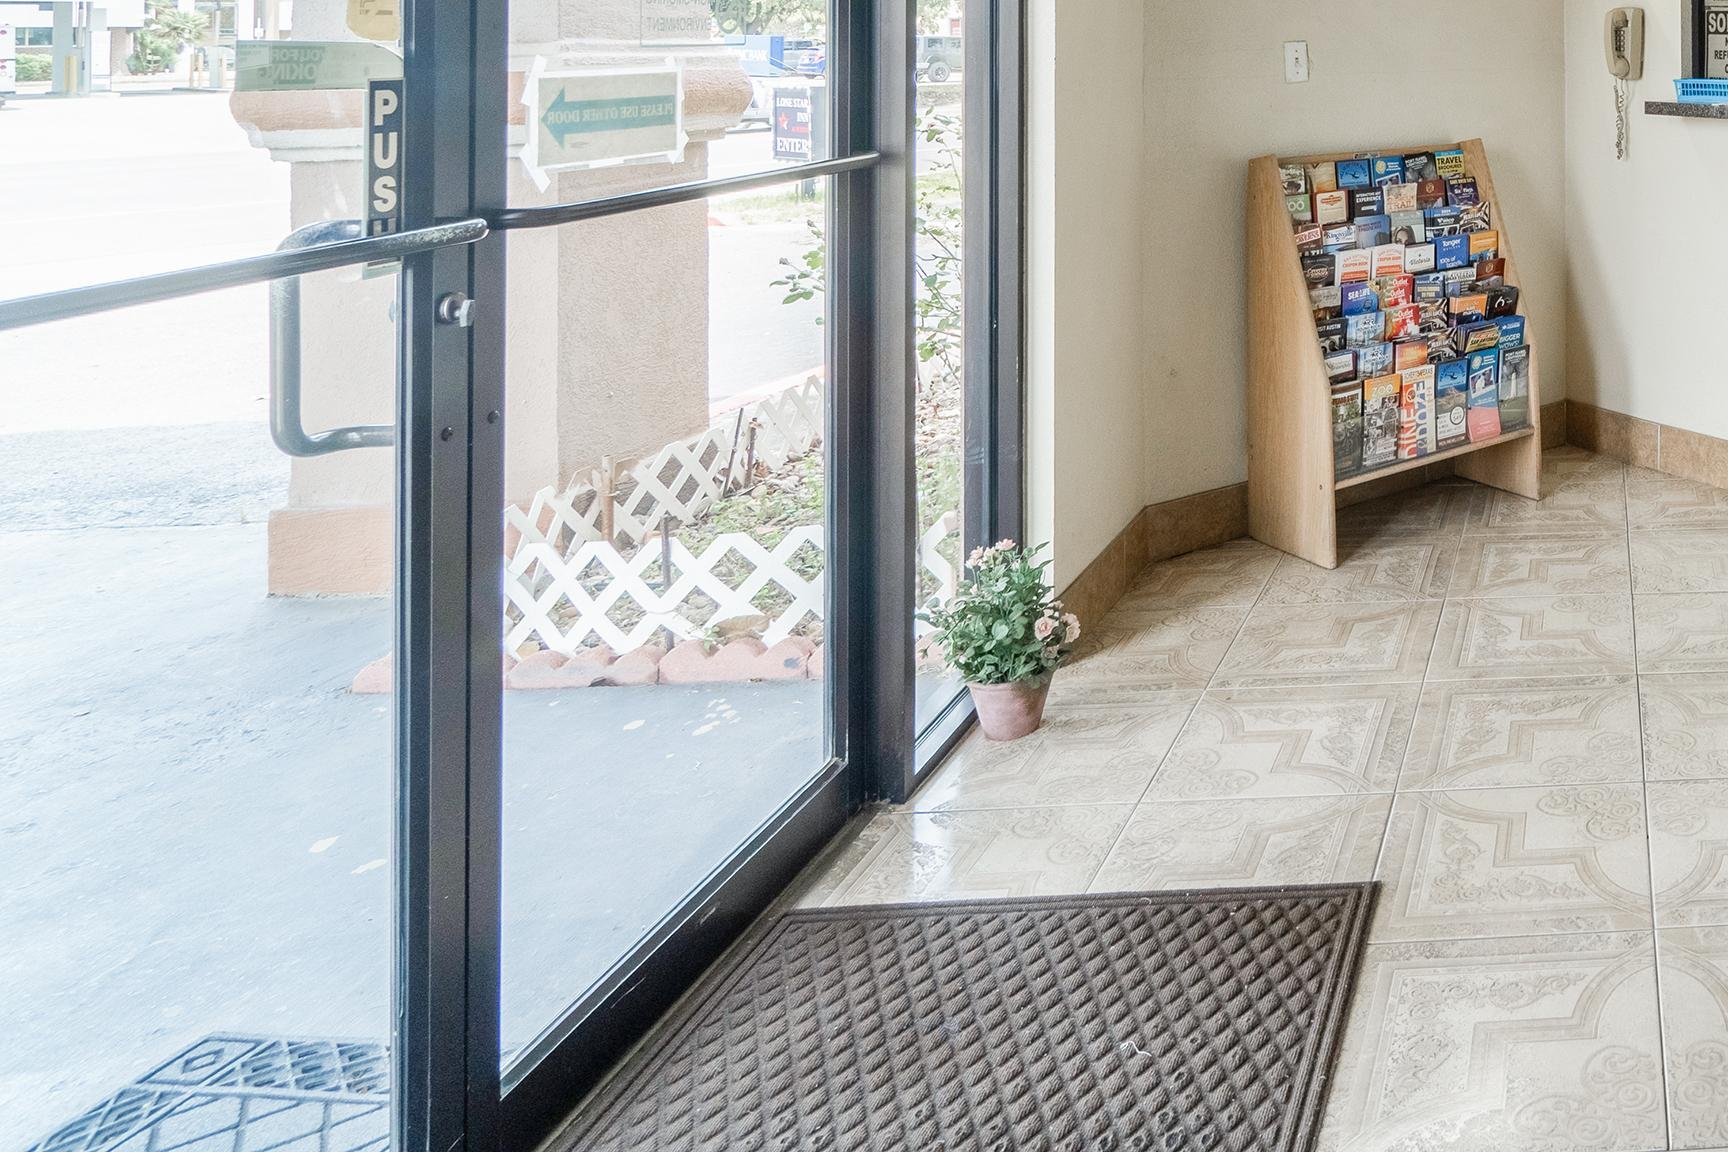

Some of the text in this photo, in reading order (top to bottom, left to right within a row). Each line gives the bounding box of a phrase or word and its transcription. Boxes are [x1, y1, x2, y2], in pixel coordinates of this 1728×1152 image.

[776, 137, 809, 152] ENTER
[1437, 156, 1462, 165] TRAVEL
[1356, 195, 1381, 203] EXPERIENCE
[1442, 239, 1461, 247] Tanger
[1391, 289, 1405, 297] Outlet
[1398, 310, 1413, 318] Outlet
